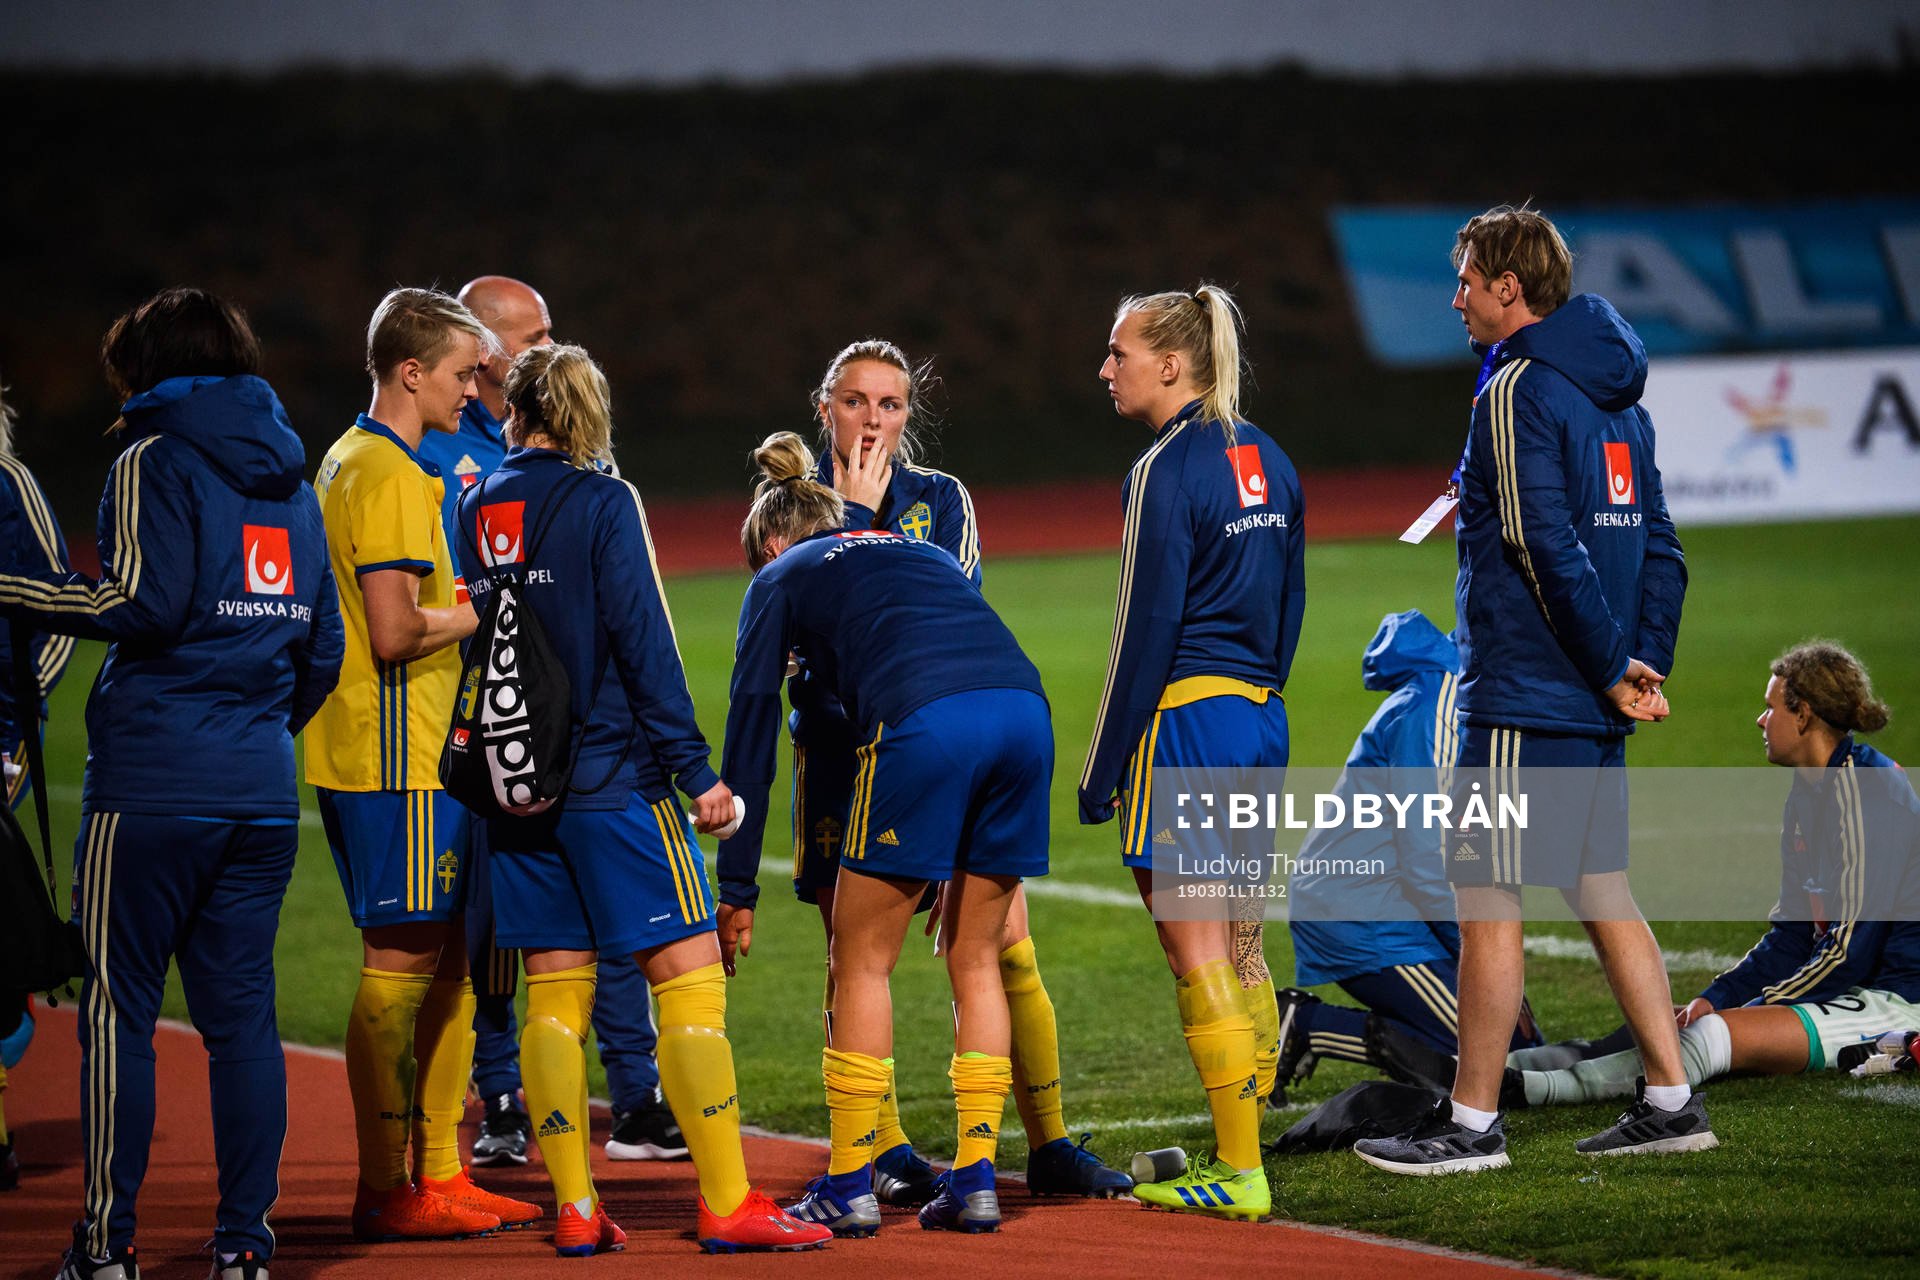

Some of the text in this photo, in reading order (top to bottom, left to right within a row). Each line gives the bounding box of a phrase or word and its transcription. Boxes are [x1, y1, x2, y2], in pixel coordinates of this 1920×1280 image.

[823, 537, 903, 561] SVENSKA
[524, 568, 555, 585] PEL
[216, 599, 287, 617] SVENSKA
[538, 1124, 577, 1137] adidas
